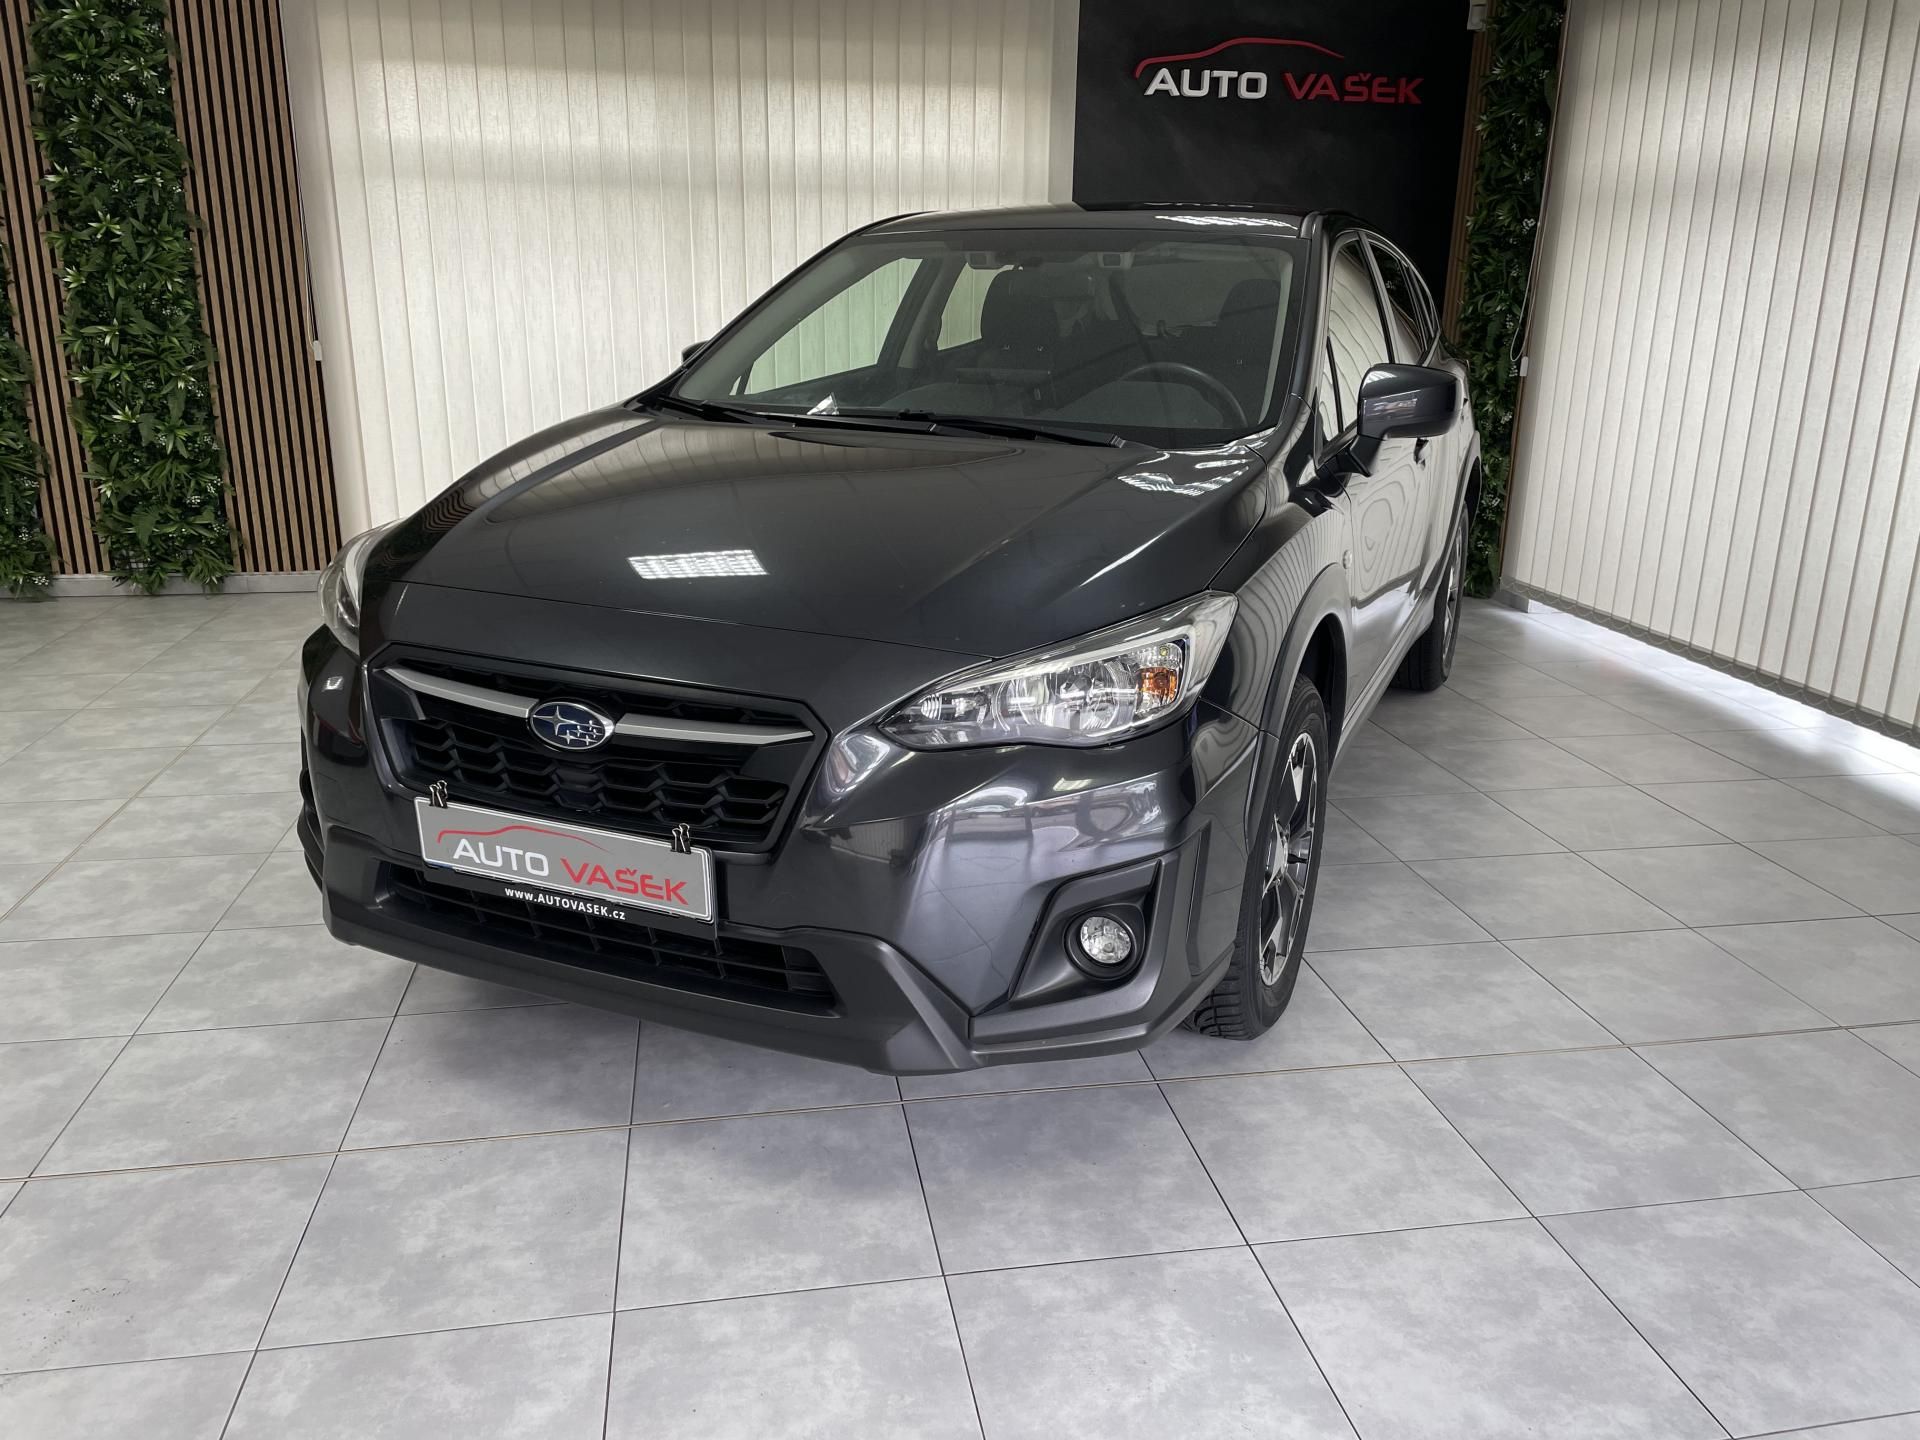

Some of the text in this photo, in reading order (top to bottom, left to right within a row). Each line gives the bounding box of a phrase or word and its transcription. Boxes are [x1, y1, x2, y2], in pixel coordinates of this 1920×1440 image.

[1143, 67, 1424, 104] AUTO VAŠEK
[453, 838, 689, 906] AUTO VAŠEK
[504, 887, 626, 921] www.AUTOVASEK.cz
